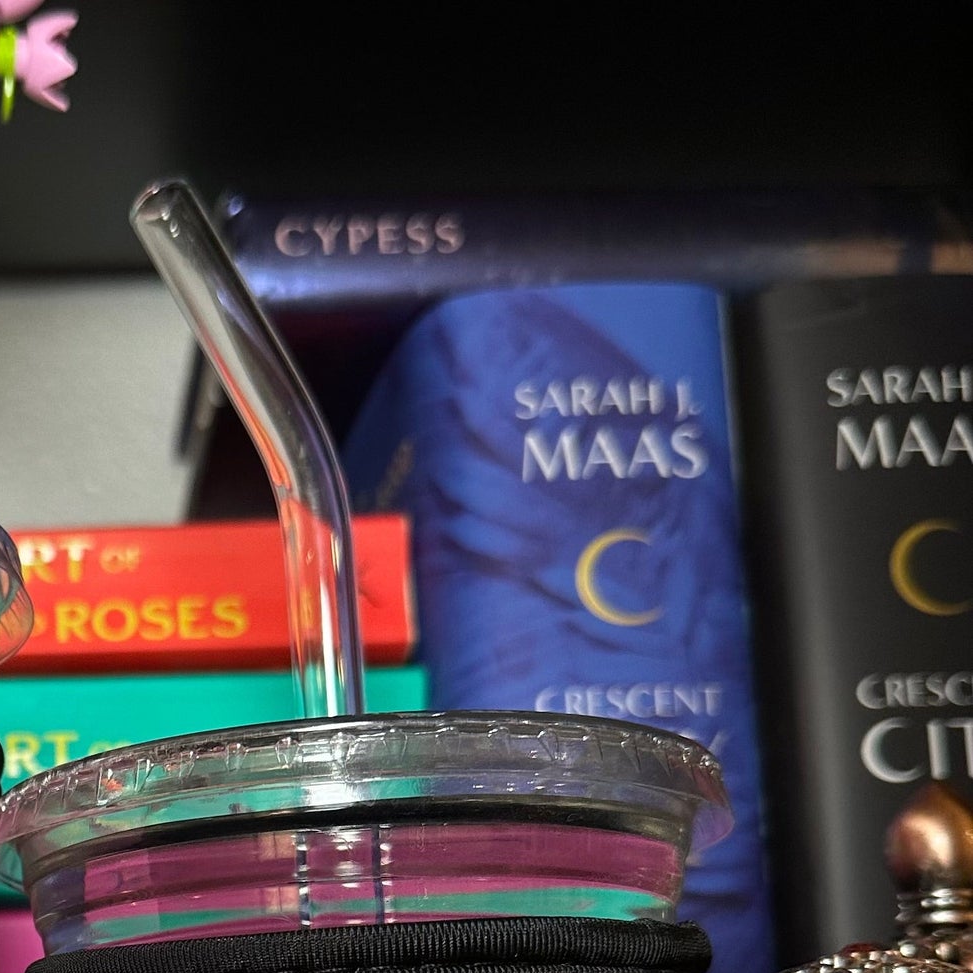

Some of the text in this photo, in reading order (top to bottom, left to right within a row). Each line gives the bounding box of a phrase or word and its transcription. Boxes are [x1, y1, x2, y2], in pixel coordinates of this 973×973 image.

[274, 212, 466, 258] CYPESS
[514, 377, 704, 422] SARAH J.
[522, 423, 708, 484] MAAS
[835, 414, 973, 471] MAA
[18, 535, 94, 584] RT
[55, 596, 248, 643] ROSES
[534, 681, 722, 719] CRESCENT
[856, 672, 973, 709] CRESC
[5, 729, 82, 779] RT
